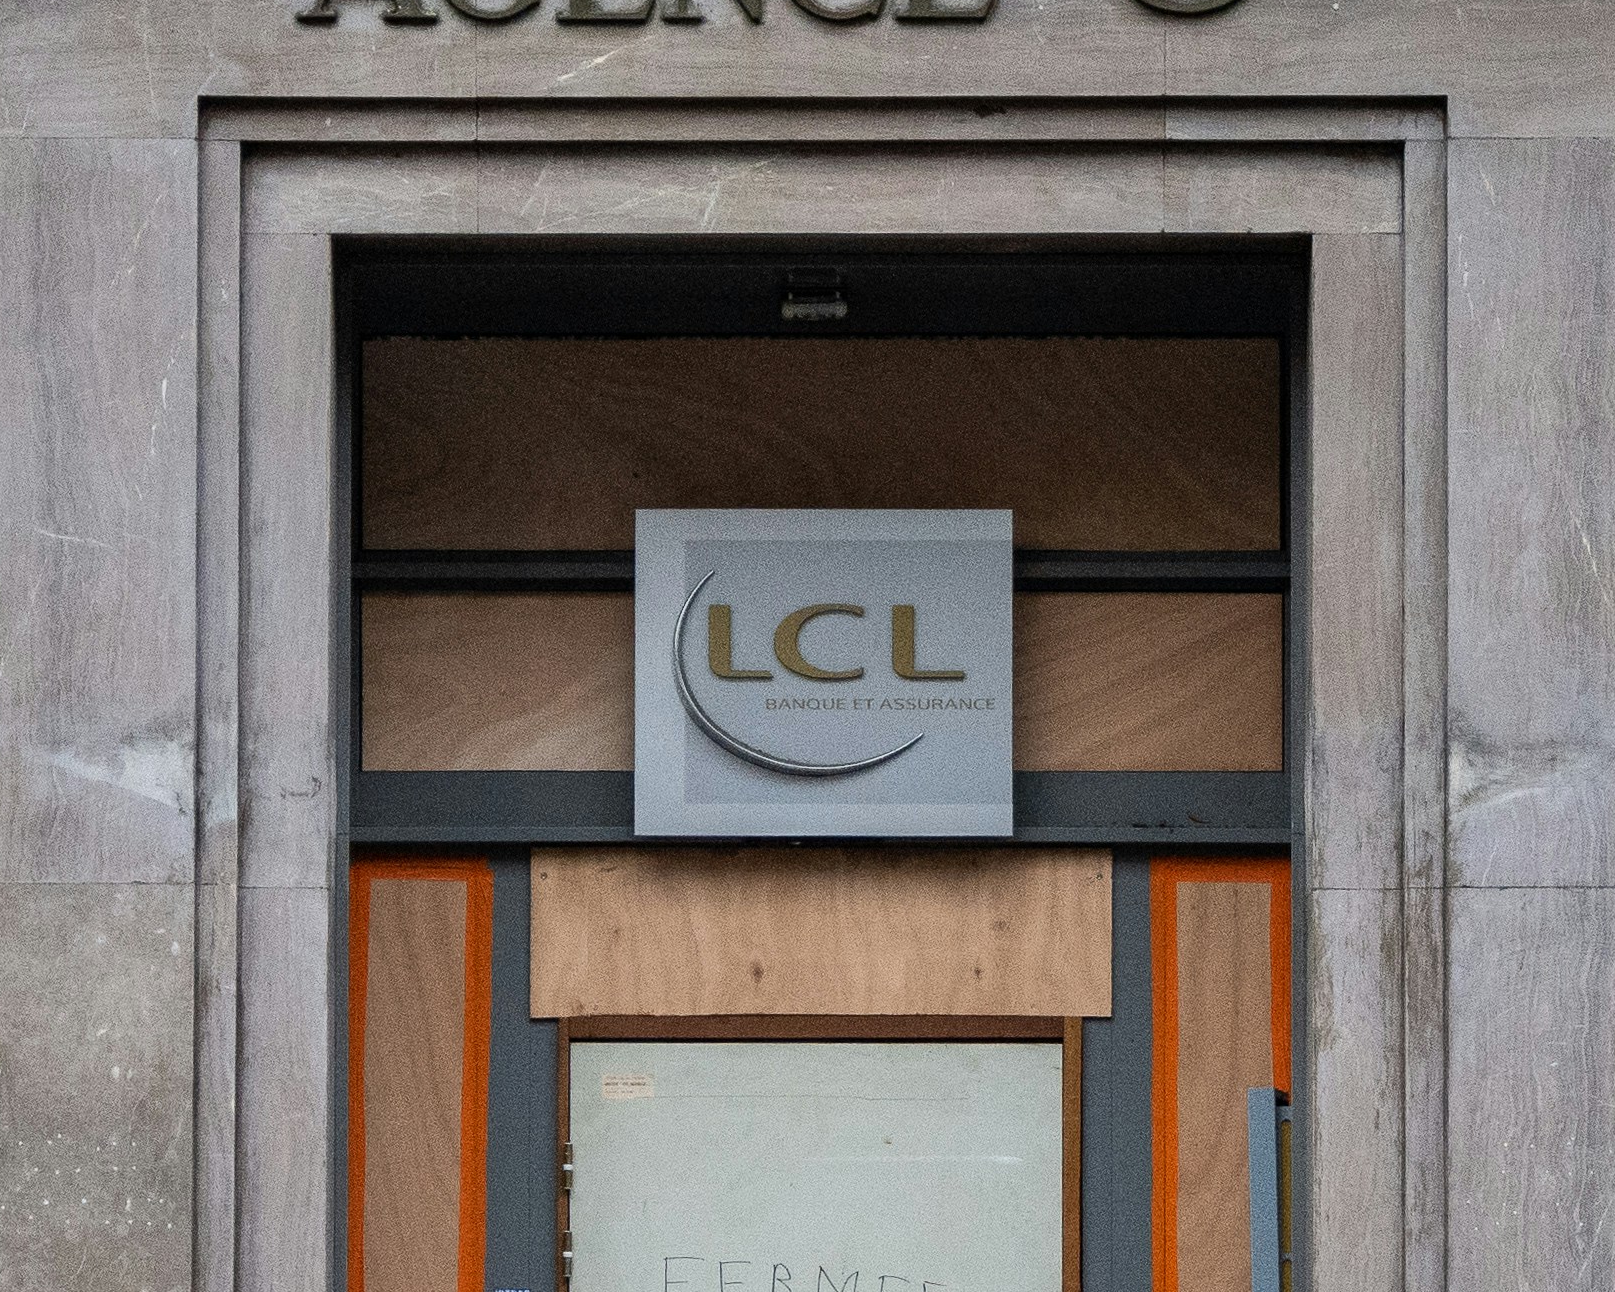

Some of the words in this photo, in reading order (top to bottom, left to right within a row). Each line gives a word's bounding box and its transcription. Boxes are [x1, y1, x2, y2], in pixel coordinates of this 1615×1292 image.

[707, 602, 965, 680] LCL
[765, 697, 846, 710] BANQUE
[853, 697, 874, 710] ET
[880, 697, 996, 710] ASSURANCE
